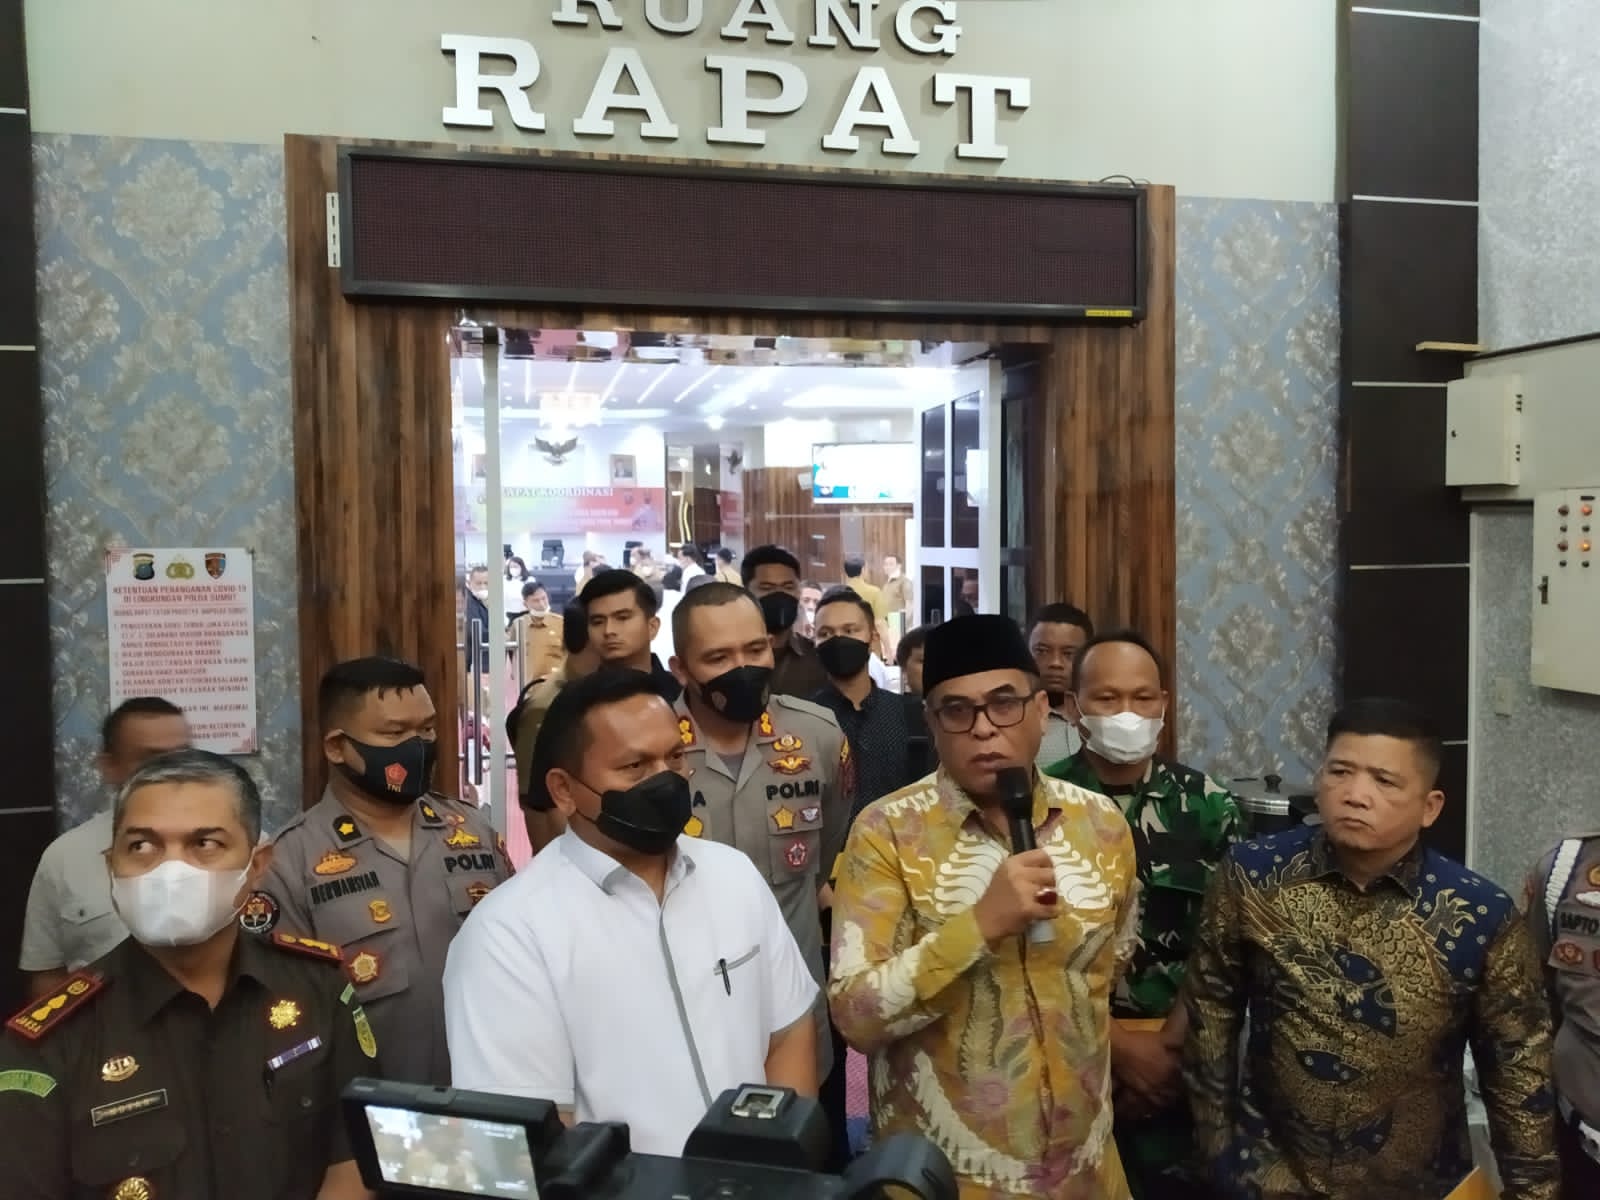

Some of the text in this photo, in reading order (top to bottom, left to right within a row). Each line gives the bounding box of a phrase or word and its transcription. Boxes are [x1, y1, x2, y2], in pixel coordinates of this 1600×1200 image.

[440, 34, 1031, 160] RAPAT
[387, 783, 401, 793] TNI
[766, 779, 820, 800] POLRI
[444, 854, 495, 872] POLRI
